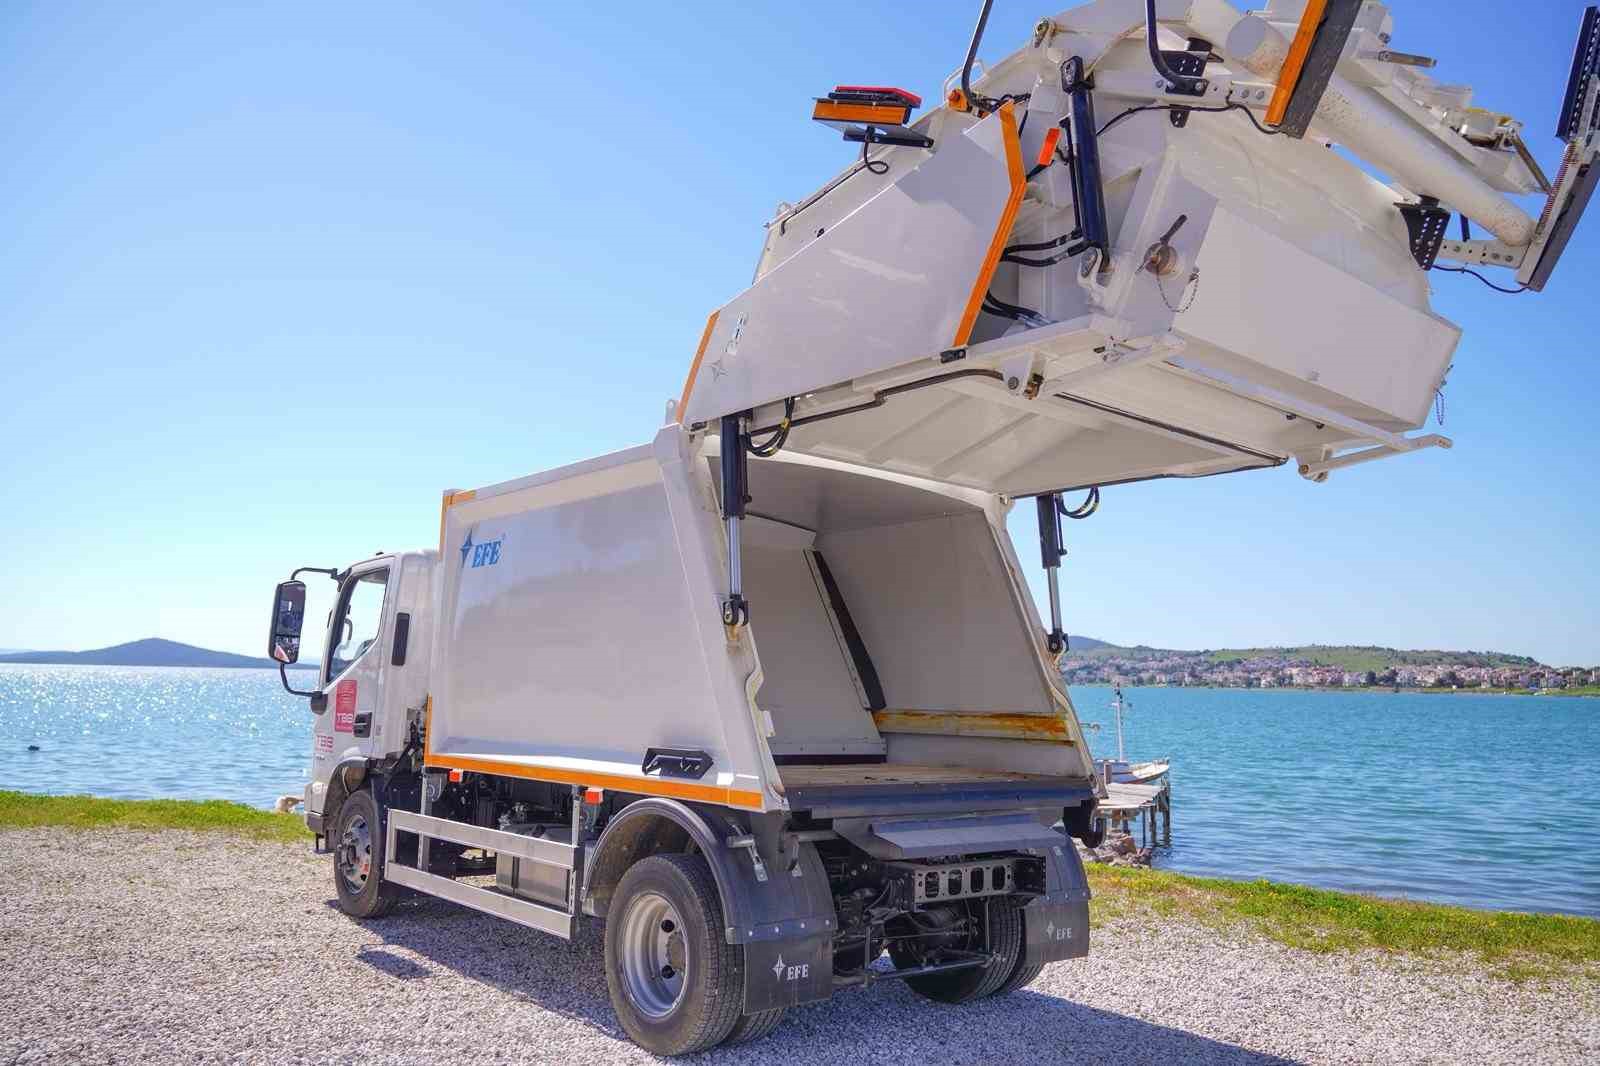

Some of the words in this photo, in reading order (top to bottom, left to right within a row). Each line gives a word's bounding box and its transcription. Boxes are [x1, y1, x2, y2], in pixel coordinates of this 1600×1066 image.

[472, 540, 501, 568] EFE
[1056, 928, 1072, 940] EFE
[787, 964, 809, 981] EFE
